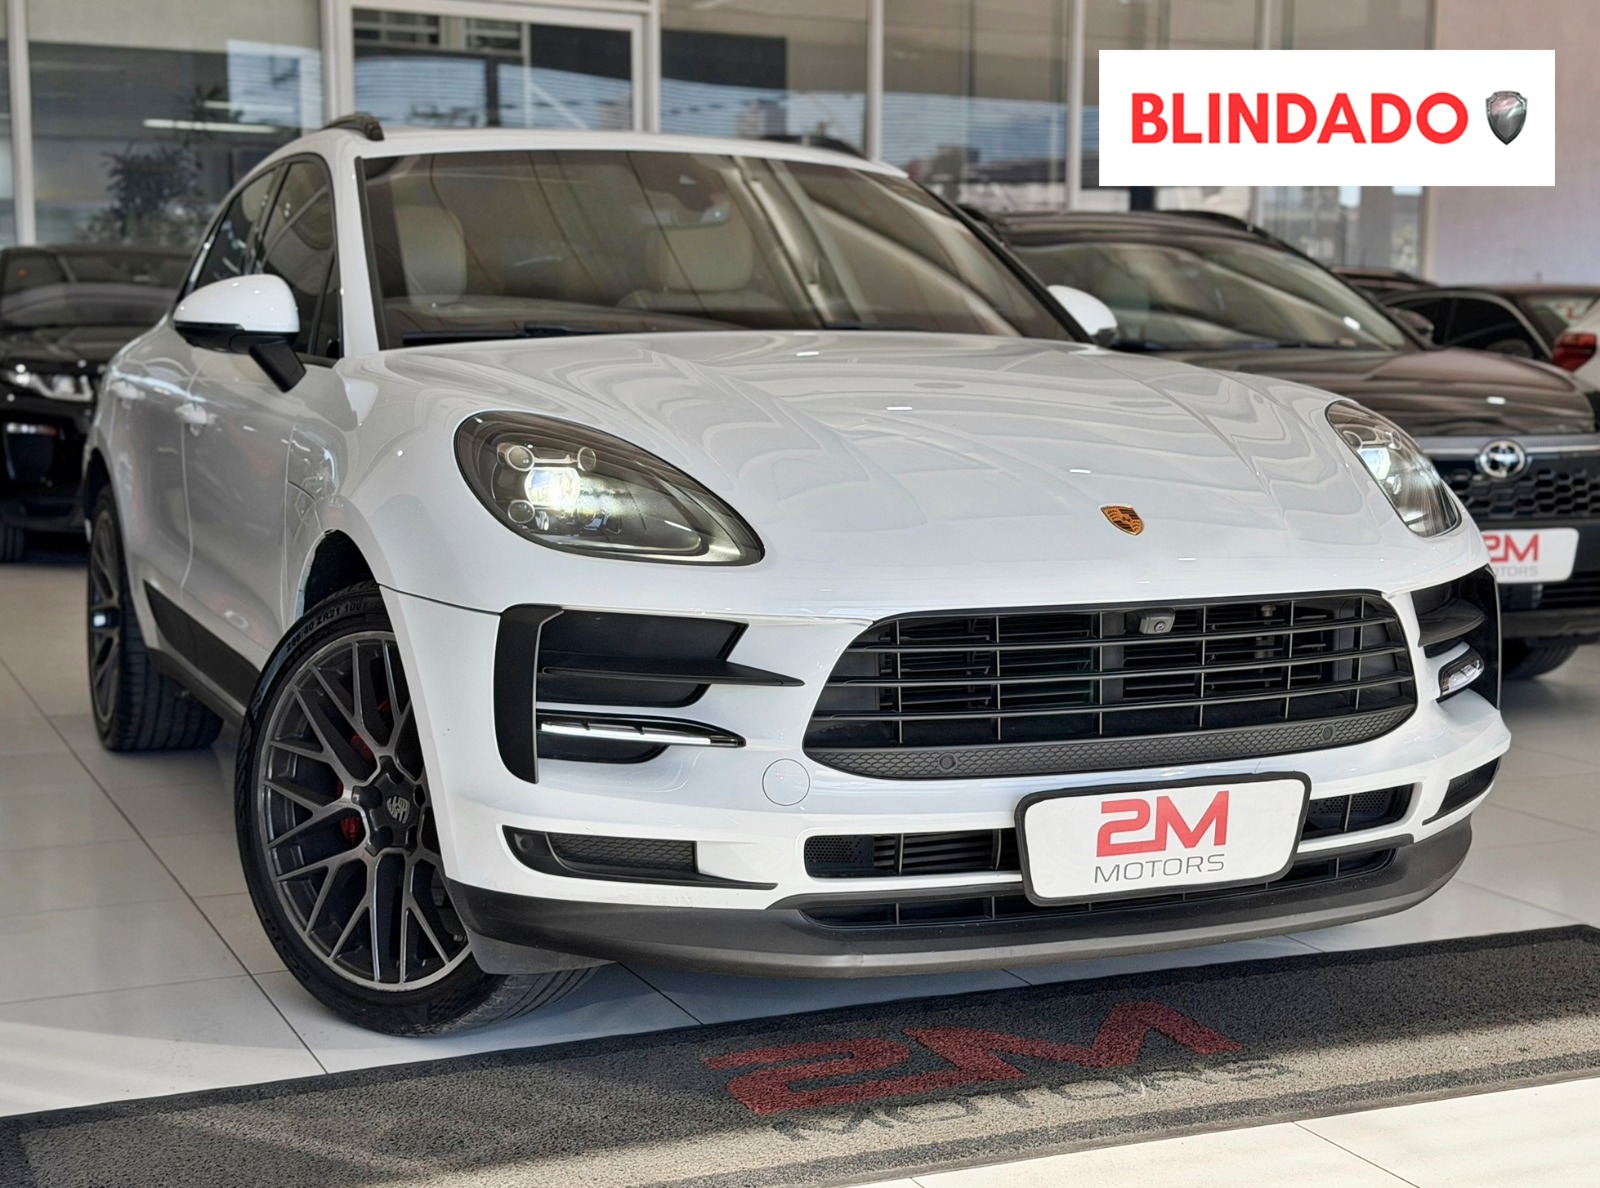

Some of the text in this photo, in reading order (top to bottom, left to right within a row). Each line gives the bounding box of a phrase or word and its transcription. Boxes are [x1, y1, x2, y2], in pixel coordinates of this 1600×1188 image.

[1483, 533, 1539, 562] 2M
[1493, 564, 1539, 578] TORS
[1096, 790, 1230, 858] 2M
[1094, 853, 1226, 884] MOTORS
[703, 1000, 1244, 1116] 2M
[772, 1055, 1293, 1141] MOTORS
